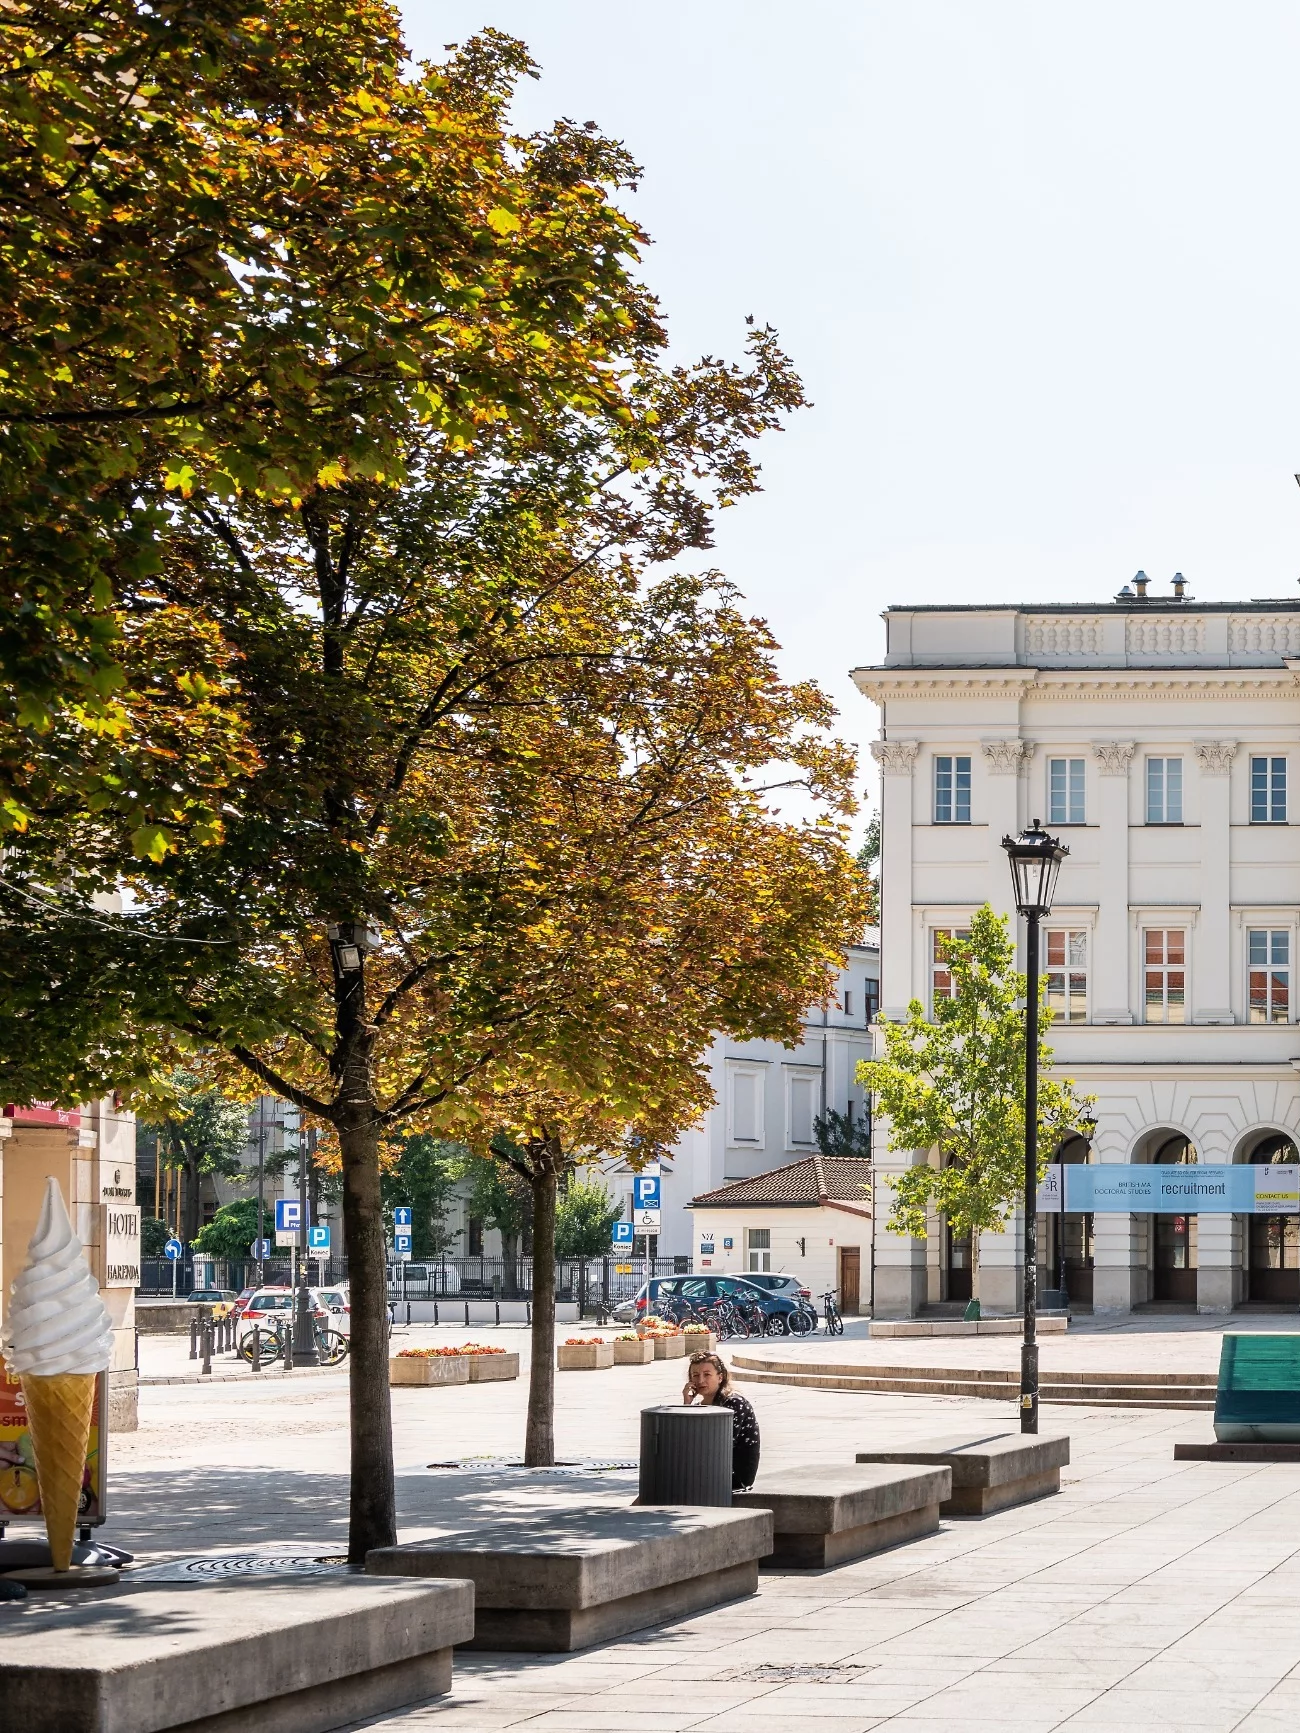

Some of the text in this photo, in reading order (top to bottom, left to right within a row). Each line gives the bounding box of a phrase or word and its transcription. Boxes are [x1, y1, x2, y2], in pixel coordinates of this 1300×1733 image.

[1161, 1182, 1226, 1195] recruitment
[108, 1213, 139, 1236] HOTEL
[310, 1248, 329, 1256] Koniec
[107, 1264, 140, 1280] HARENDA
